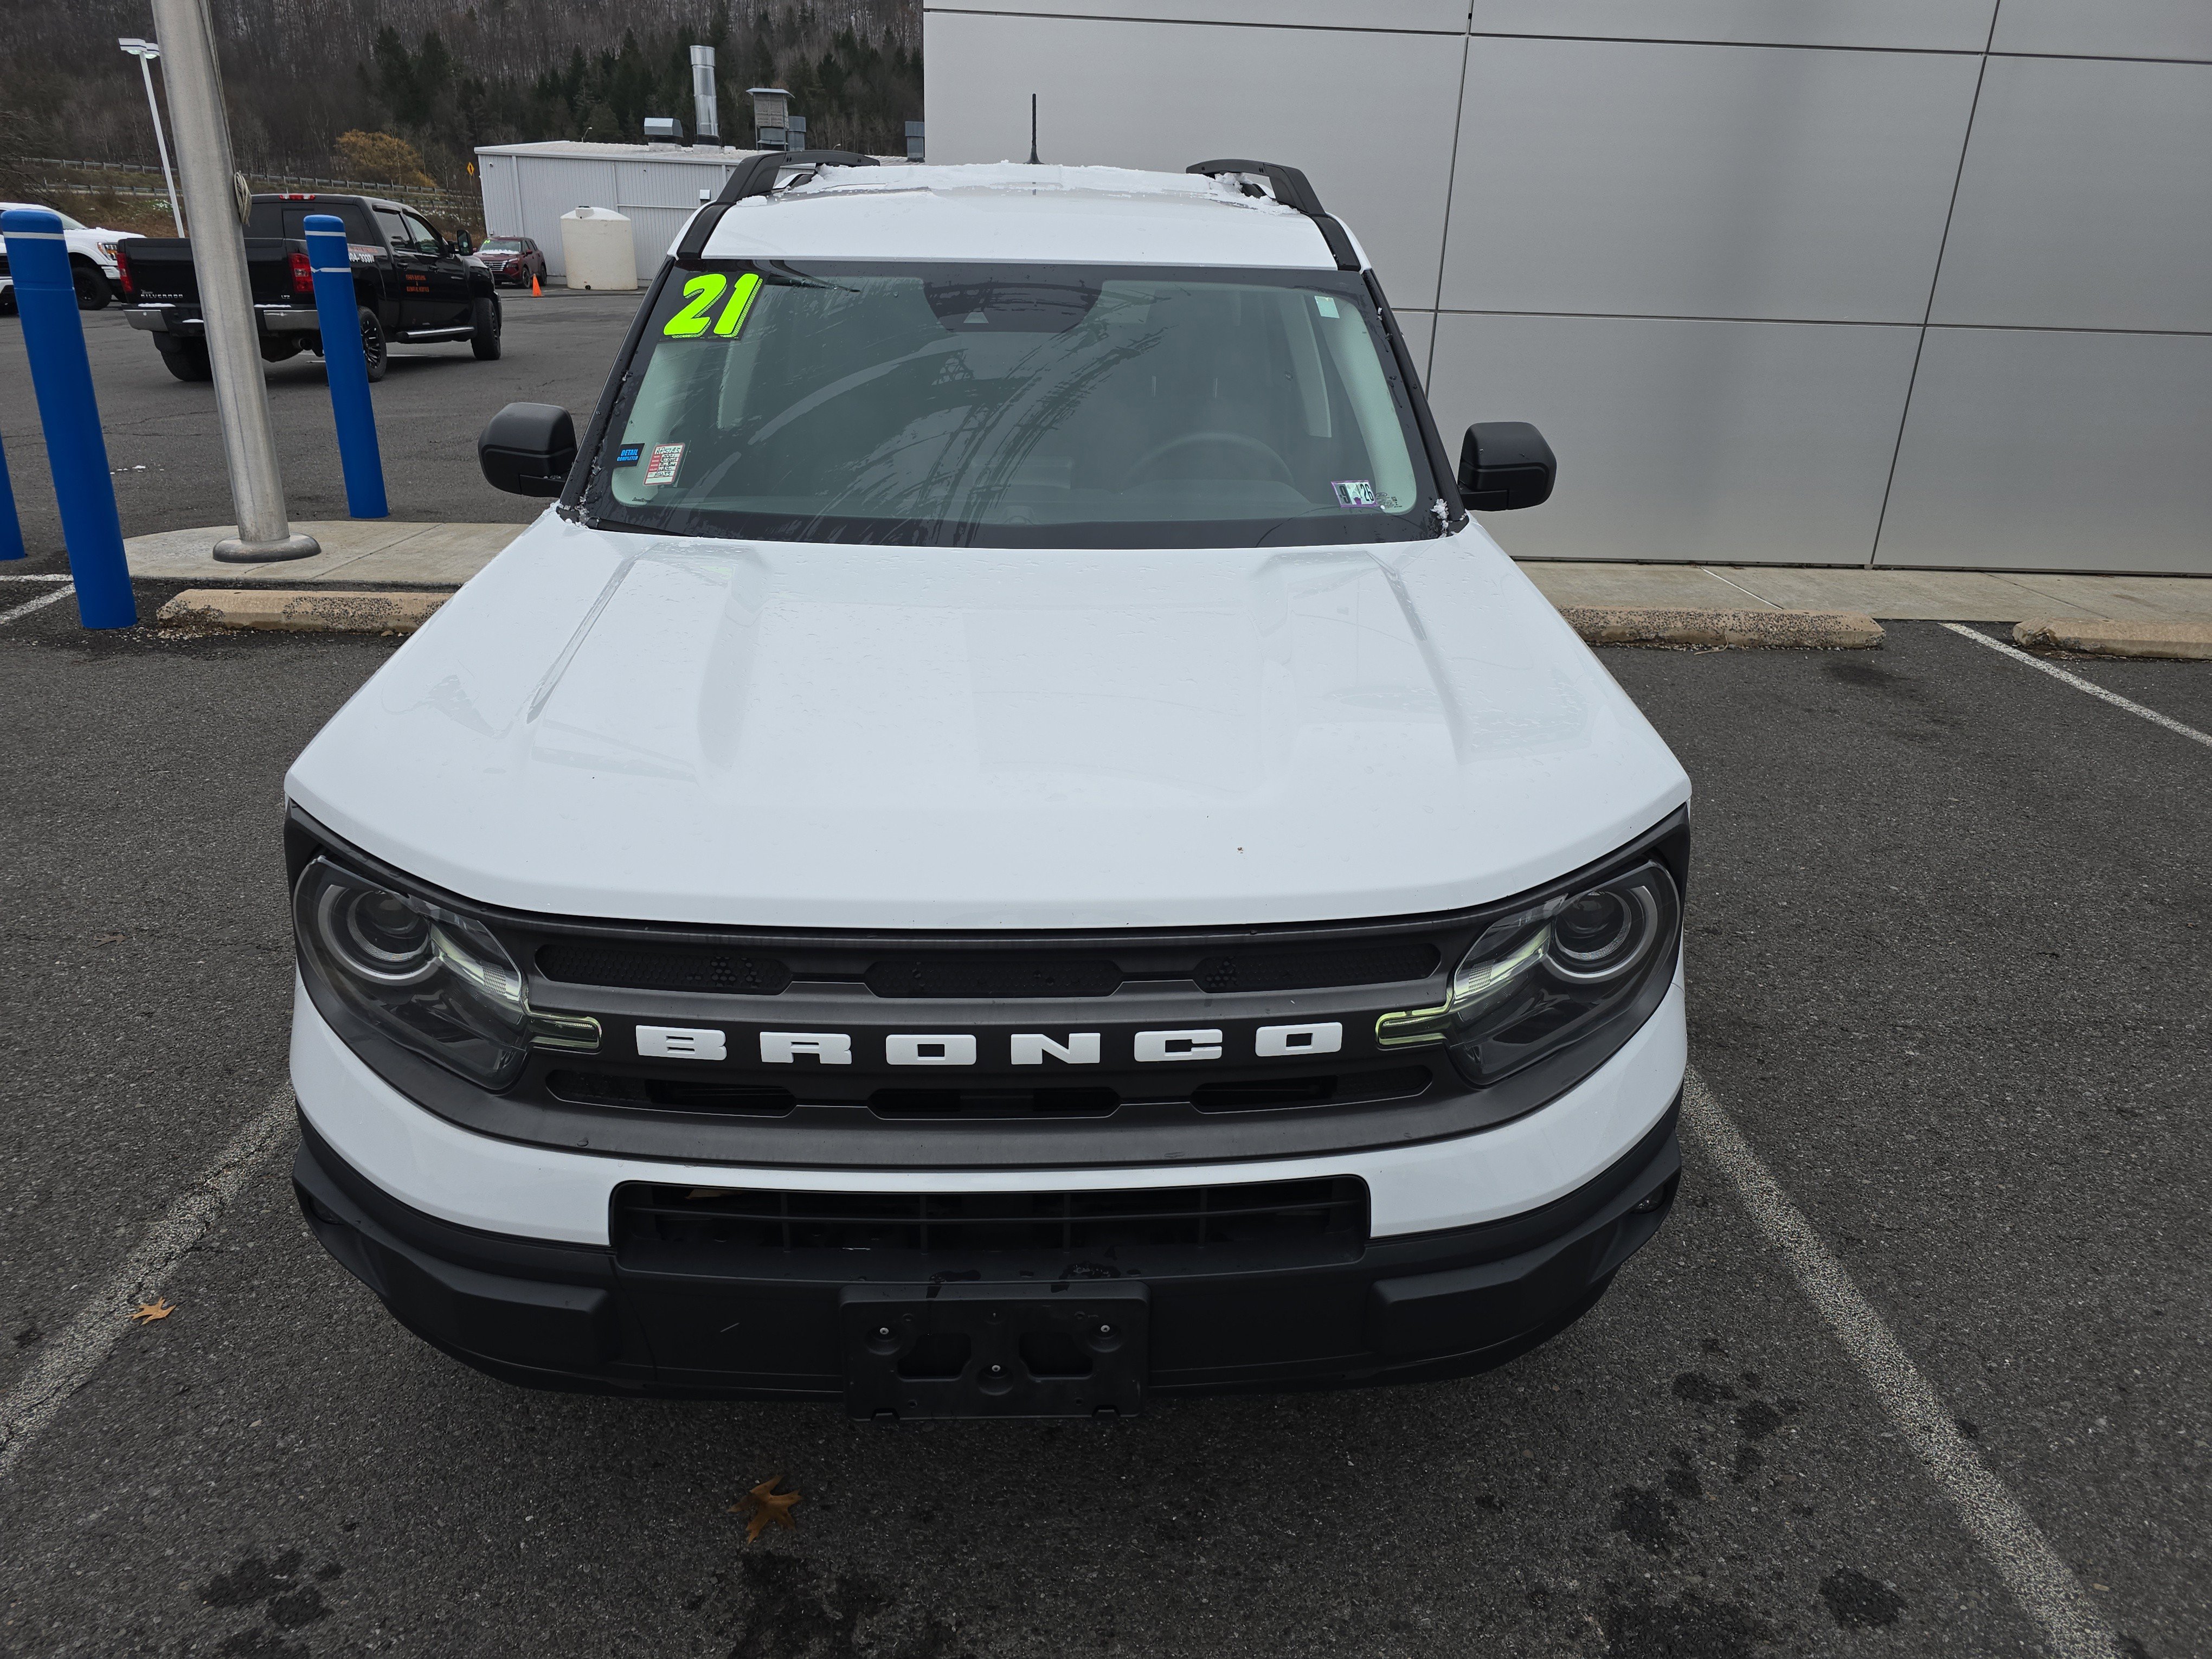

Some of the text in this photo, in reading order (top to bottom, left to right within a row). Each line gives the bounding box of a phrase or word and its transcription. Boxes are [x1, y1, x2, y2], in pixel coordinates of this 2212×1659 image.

[664, 273, 762, 338] 21
[1339, 484, 1374, 504] 9 26
[635, 1021, 1342, 1065] BRONCO
